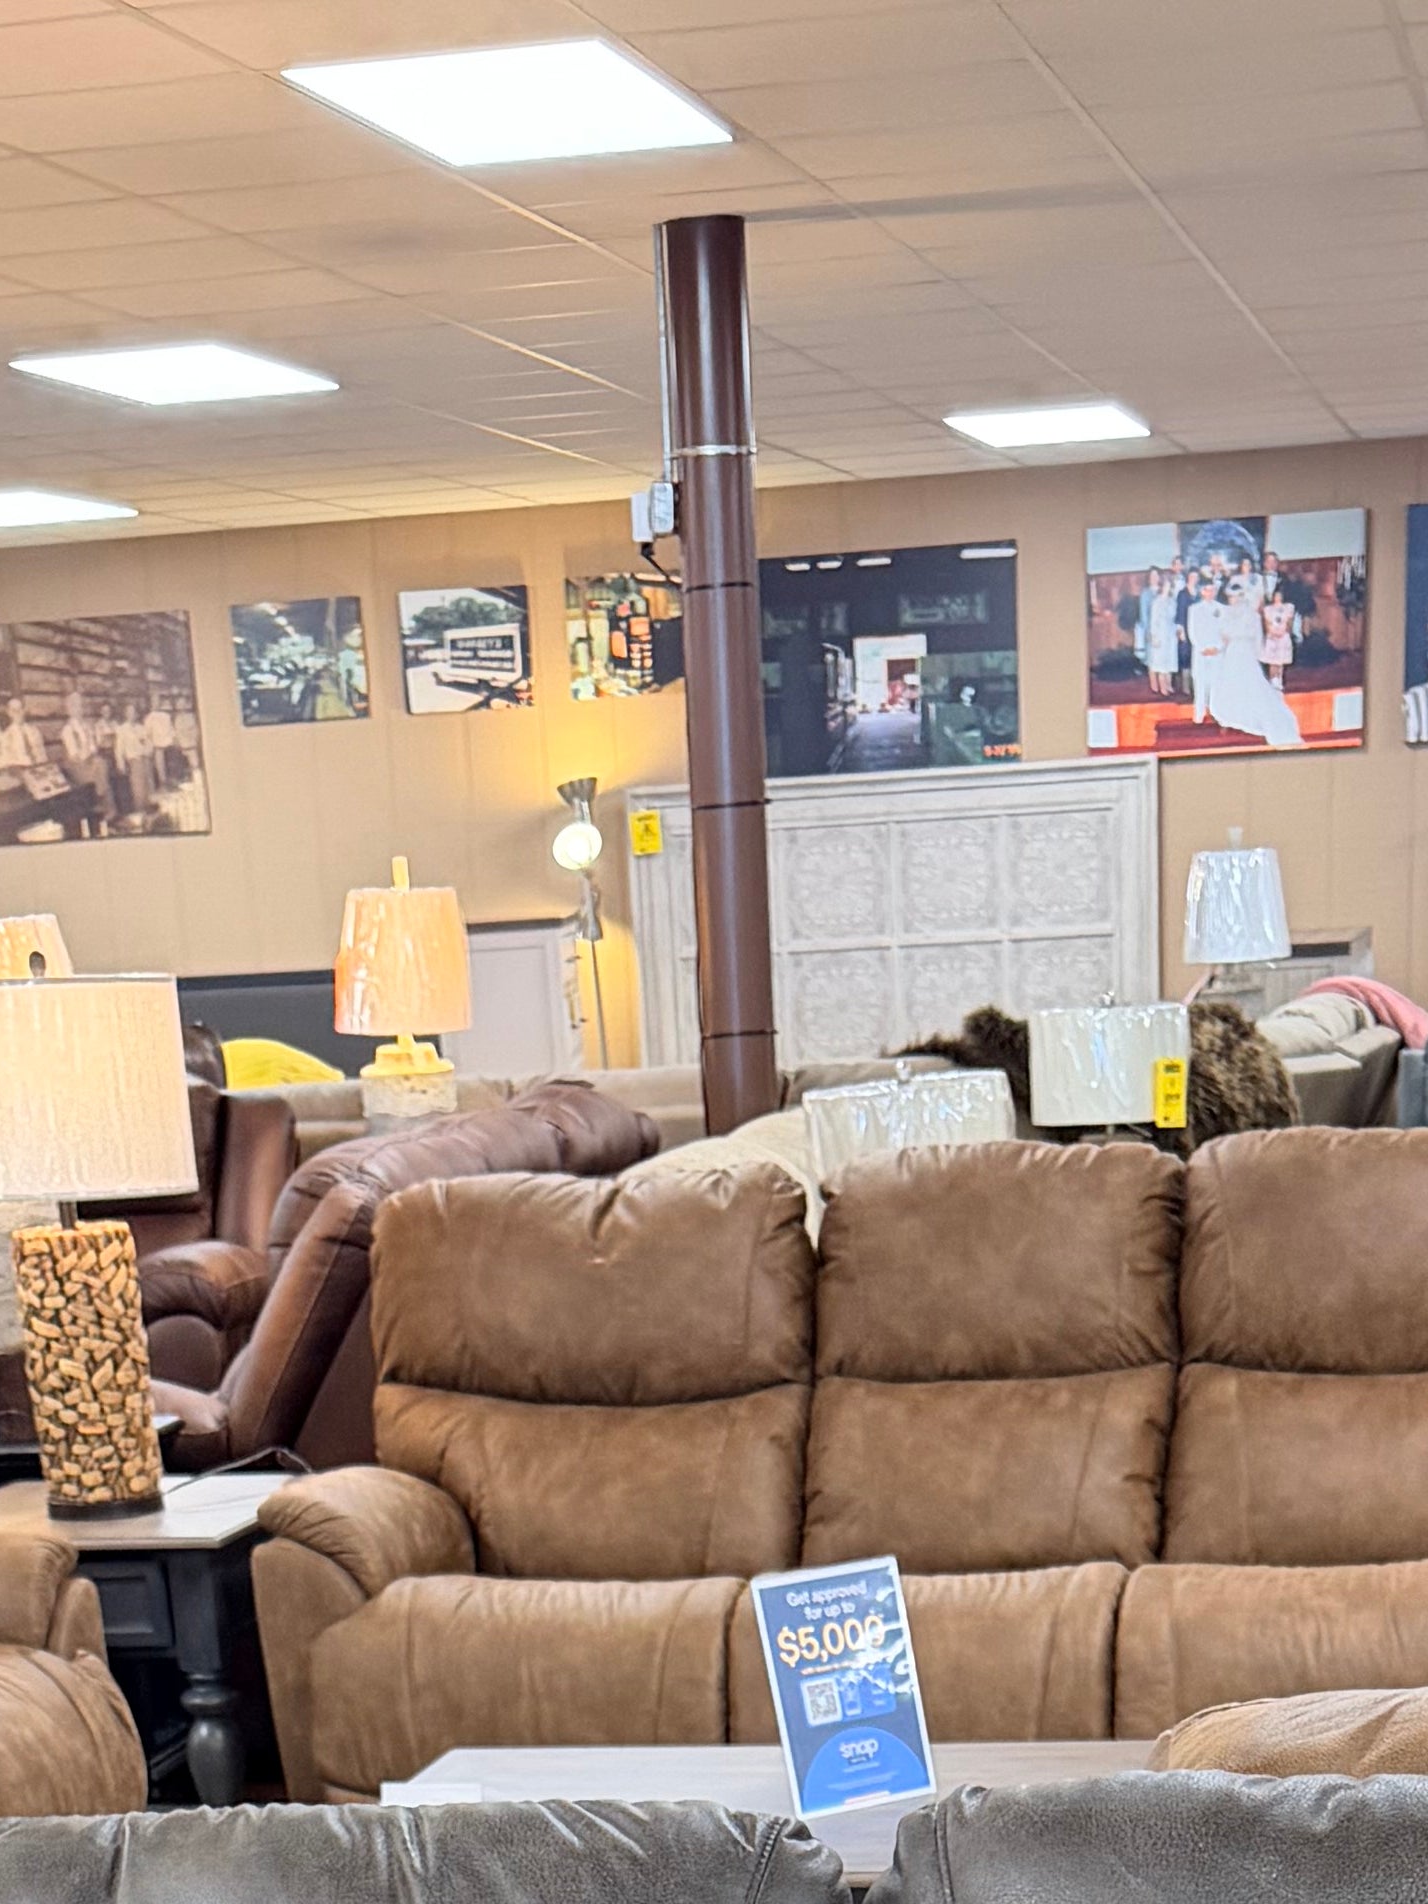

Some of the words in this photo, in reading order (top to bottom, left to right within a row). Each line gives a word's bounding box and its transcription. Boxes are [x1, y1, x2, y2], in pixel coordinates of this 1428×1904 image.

[785, 1589, 810, 1607] Get
[810, 1579, 868, 1605] approved
[803, 1604, 823, 1621] for
[823, 1603, 841, 1618] up
